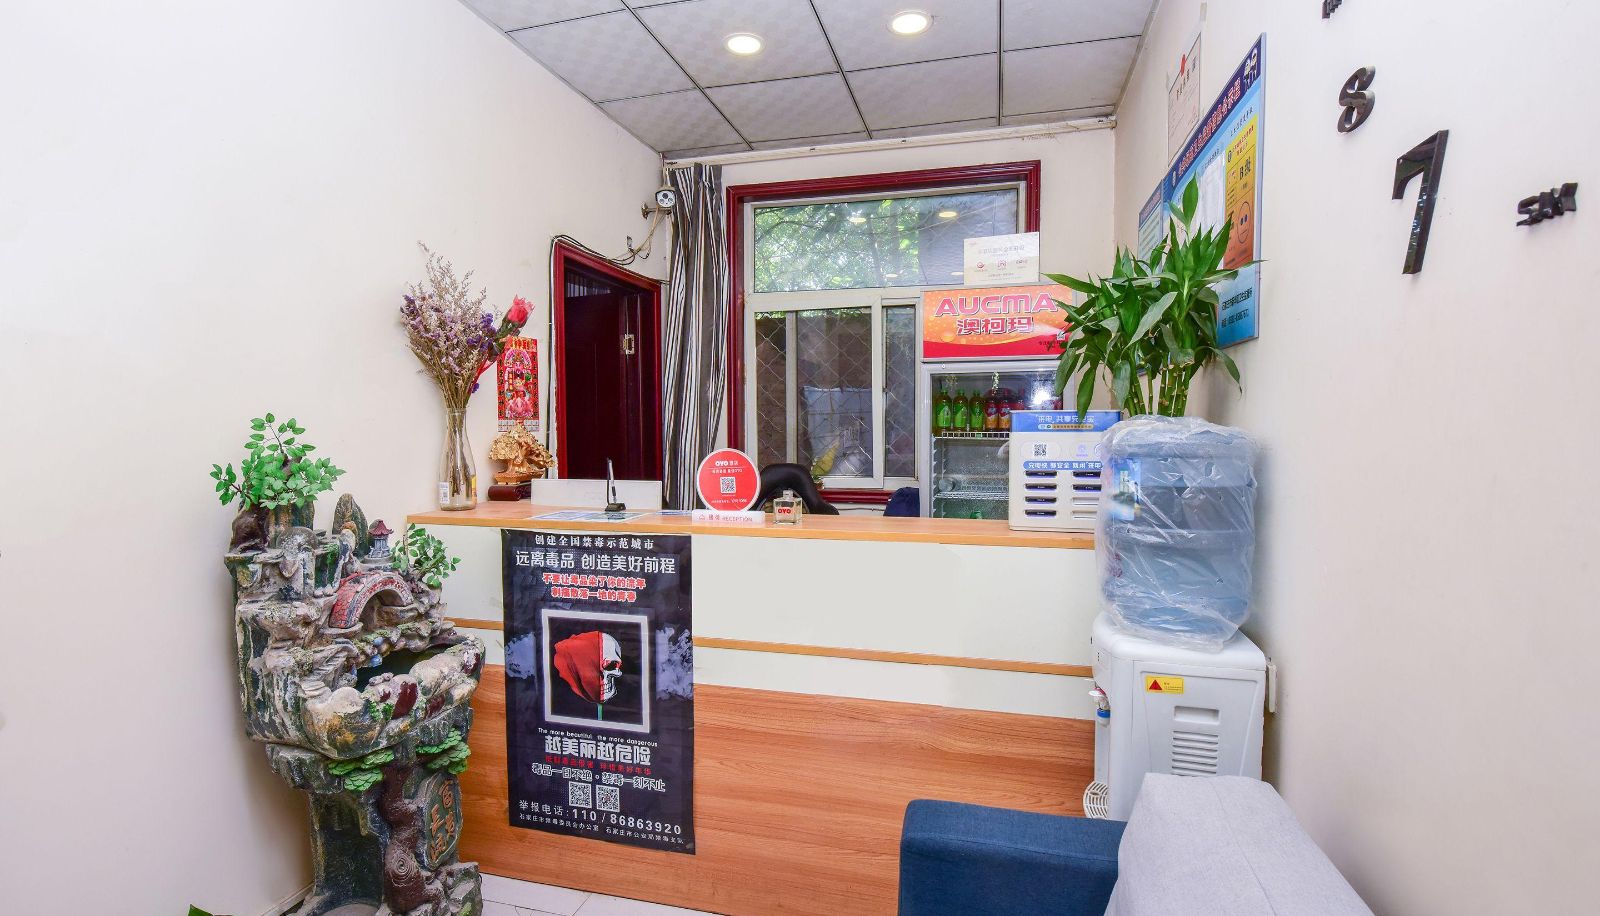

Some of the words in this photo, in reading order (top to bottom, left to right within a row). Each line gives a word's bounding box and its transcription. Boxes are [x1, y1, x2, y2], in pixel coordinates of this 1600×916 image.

[1337, 65, 1376, 133] 8
[1392, 129, 1449, 274] 7
[934, 292, 1060, 318] AUCMA
[957, 316, 1034, 336] 澳柯玛
[1056, 415, 1095, 423] 共享充宝
[535, 534, 654, 550] 创建全国禁毒示范城市
[515, 550, 575, 569] 远离毒品
[580, 553, 676, 574] 创造美好前程
[544, 734, 652, 766] 越美丽越危险
[626, 738, 658, 748] dangerous
[610, 813, 682, 835] 86863920
